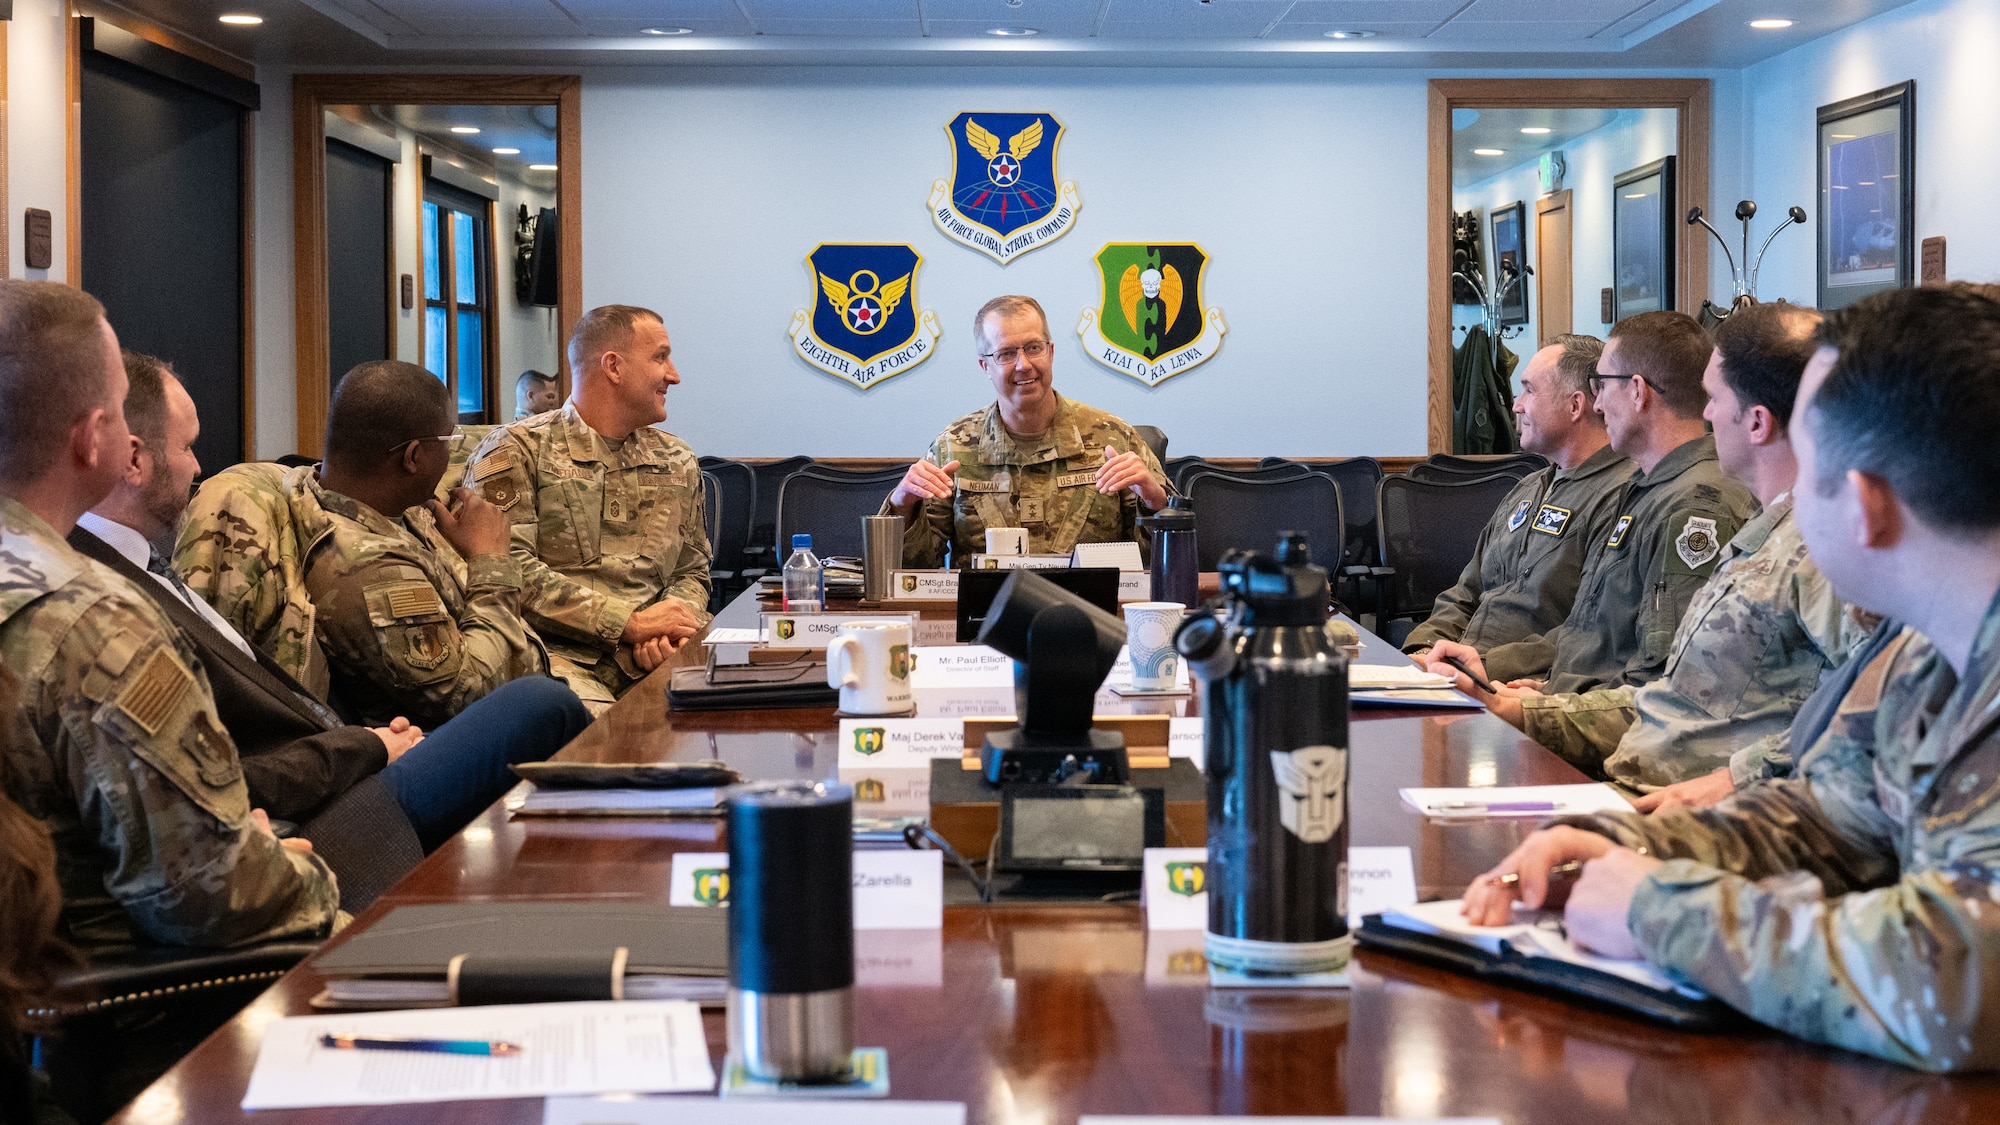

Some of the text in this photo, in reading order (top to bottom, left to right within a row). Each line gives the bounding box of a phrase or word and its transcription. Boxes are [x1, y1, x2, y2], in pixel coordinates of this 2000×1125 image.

[937, 207, 1072, 257] AIR FORCE GLOBAL STRIKE COMMAND
[800, 336, 926, 383] EIGHTH AIR FORCE
[1103, 348, 1202, 381] KIAI O KA LEWA
[1074, 474, 1086, 484] AIR
[969, 481, 1000, 491] NEUMAN
[919, 579, 944, 588] CMSgt
[809, 623, 838, 635] CMSgt
[939, 655, 1007, 665] Mr. Paul Elliott
[892, 733, 910, 743] Maj
[914, 732, 945, 742] Derek
[1169, 732, 1204, 741] arson
[908, 745, 938, 753] Deputy
[852, 873, 912, 888] Zarella
